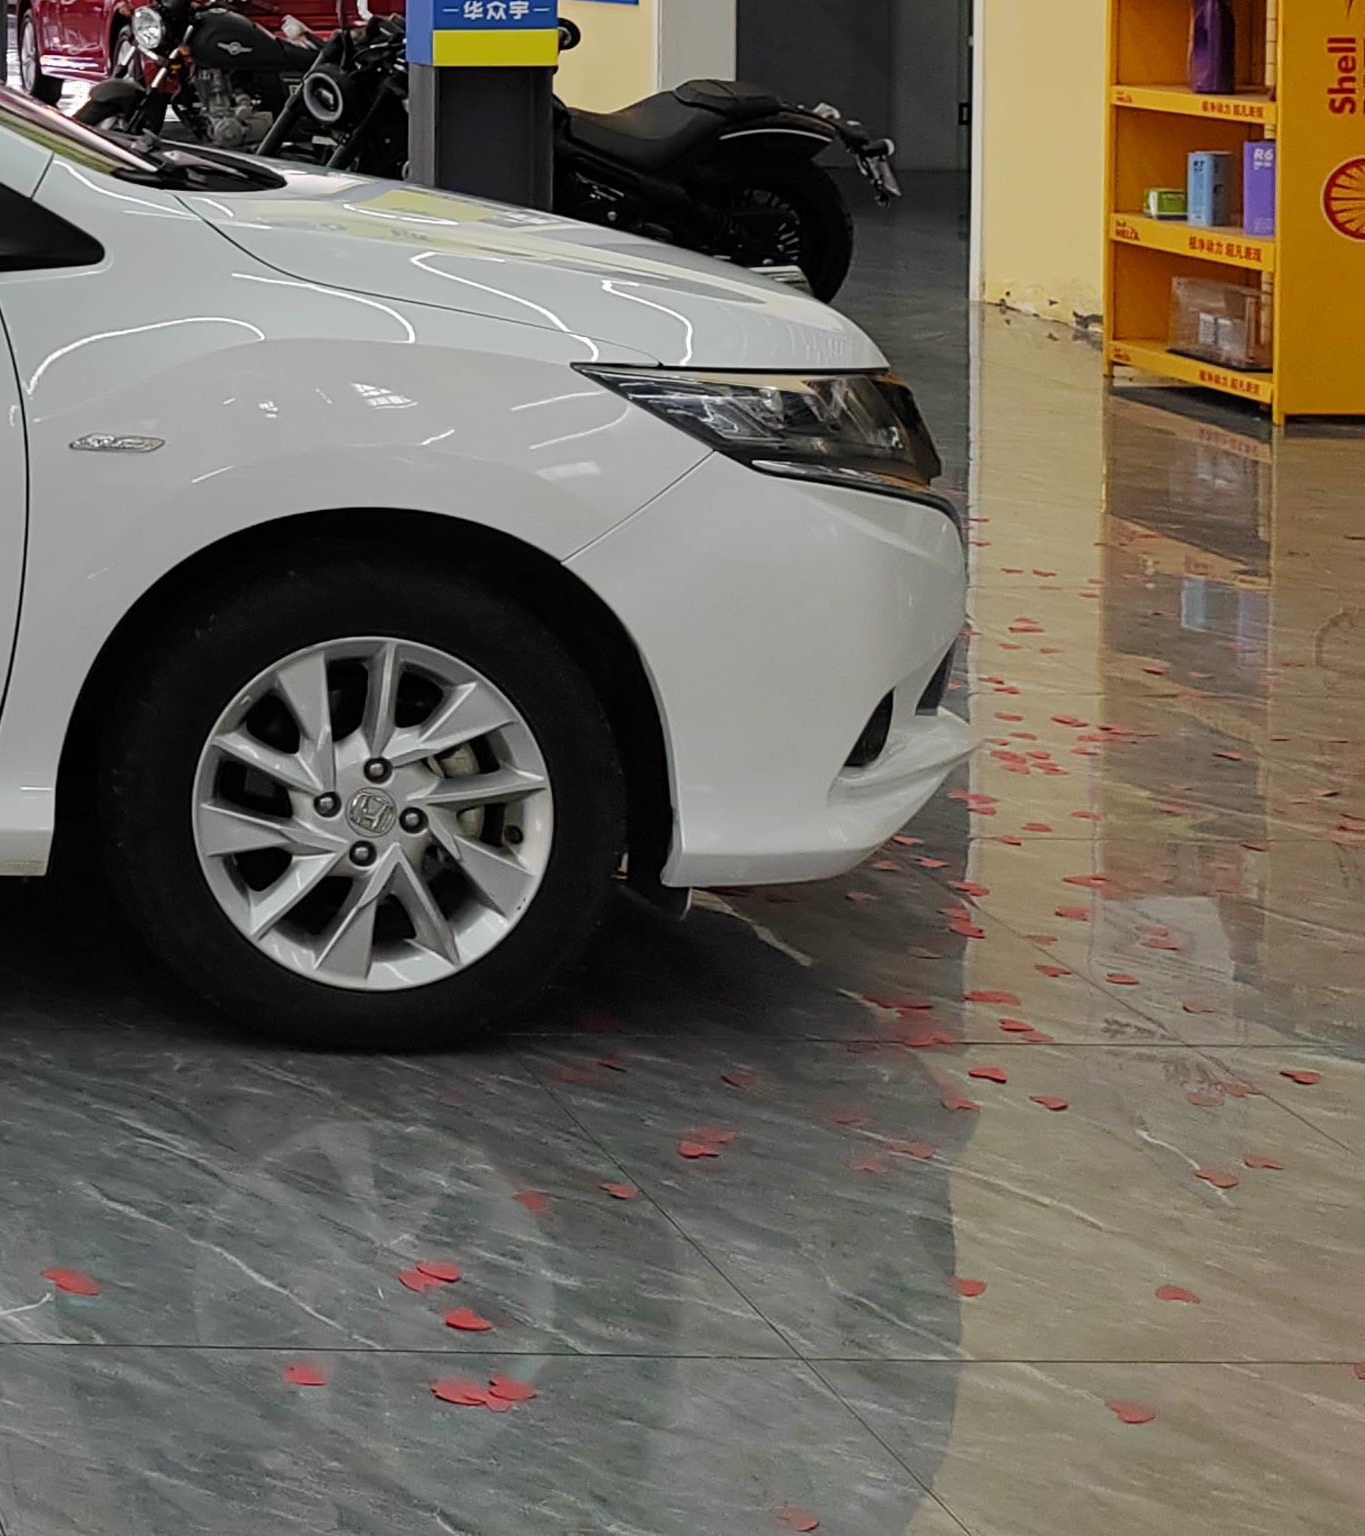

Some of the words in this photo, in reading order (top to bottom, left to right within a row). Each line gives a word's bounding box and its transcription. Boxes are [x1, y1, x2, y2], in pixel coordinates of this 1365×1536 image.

[463, 0, 530, 21] 华众宇
[1327, 37, 1356, 115] Shell
[1253, 148, 1274, 161] R6
